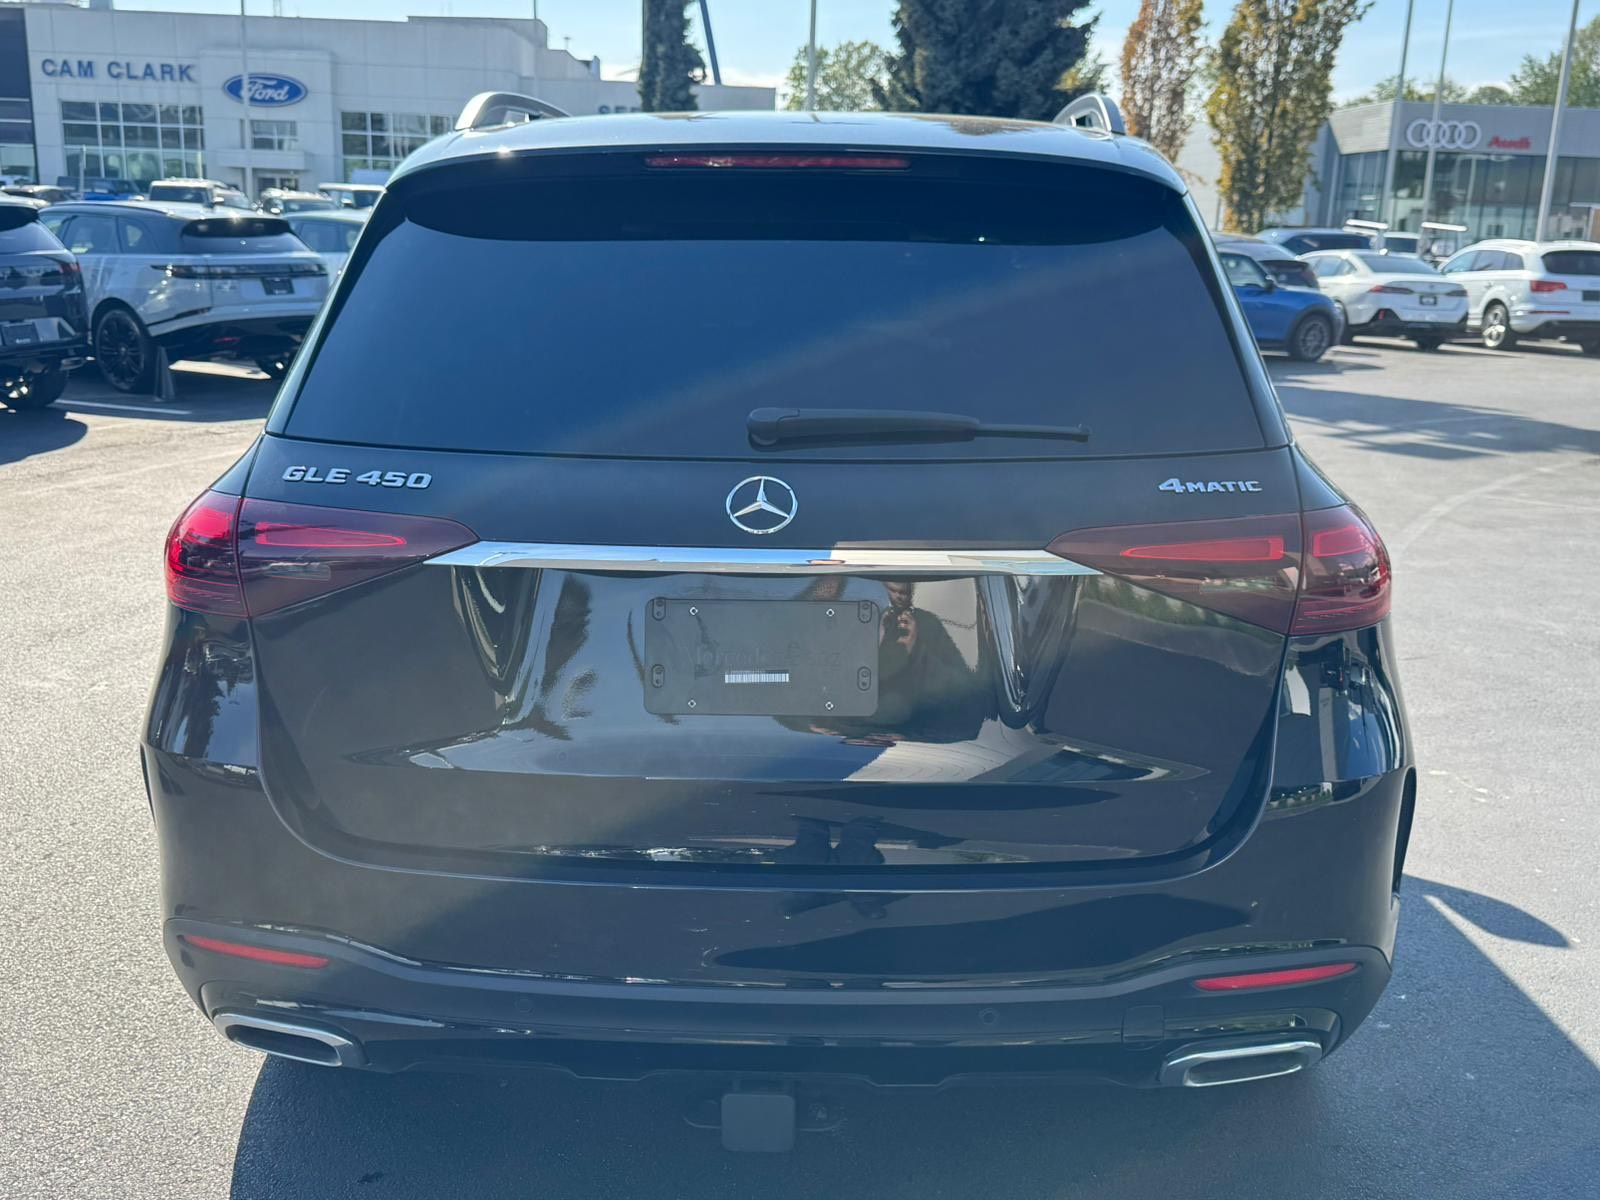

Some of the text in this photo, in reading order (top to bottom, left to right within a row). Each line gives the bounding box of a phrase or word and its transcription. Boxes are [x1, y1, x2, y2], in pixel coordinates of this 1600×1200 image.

[41, 58, 198, 83] CAM CLARK
[240, 77, 290, 101] Ford
[282, 465, 433, 489] GLE 450
[1159, 478, 1263, 493] 4MATIC
